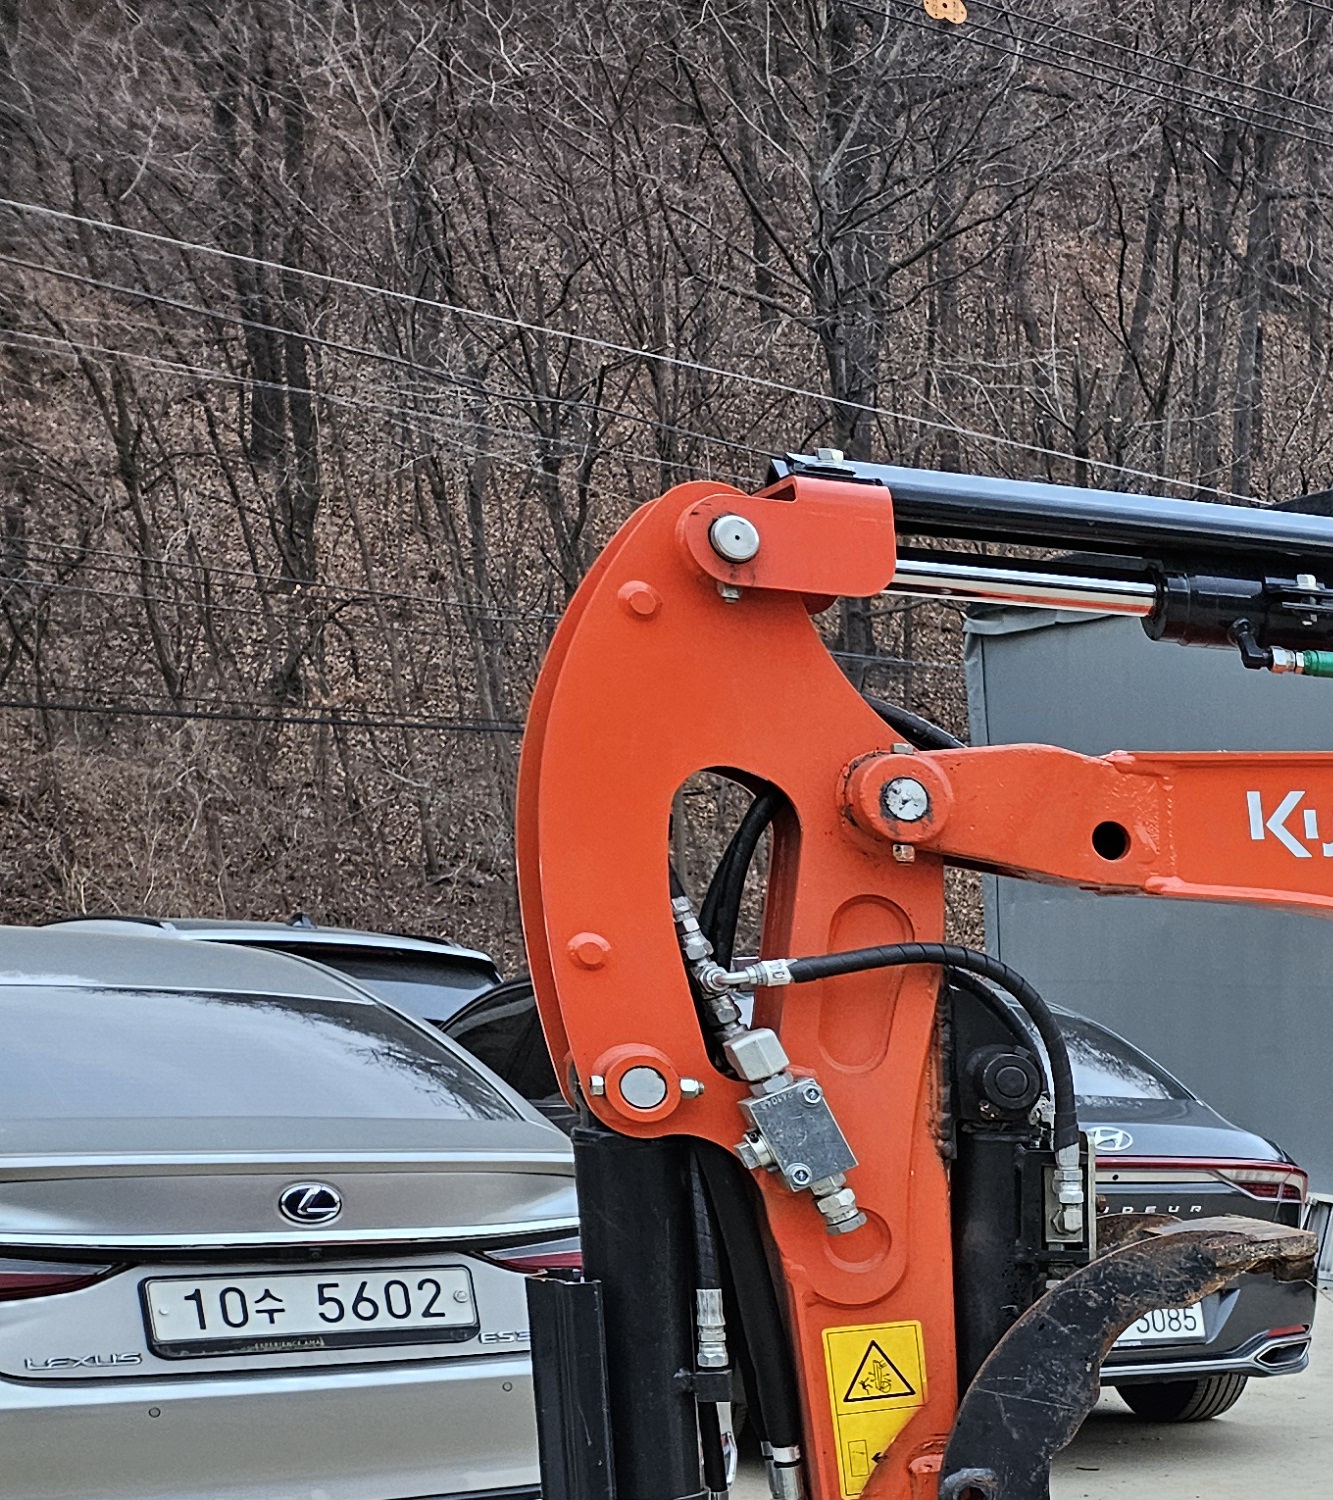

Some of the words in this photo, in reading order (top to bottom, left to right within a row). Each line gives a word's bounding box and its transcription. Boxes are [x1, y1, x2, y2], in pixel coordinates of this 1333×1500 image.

[183, 1287, 286, 1330] 10수
[317, 1278, 446, 1323] 5602
[25, 1352, 143, 1371] LEXUS
